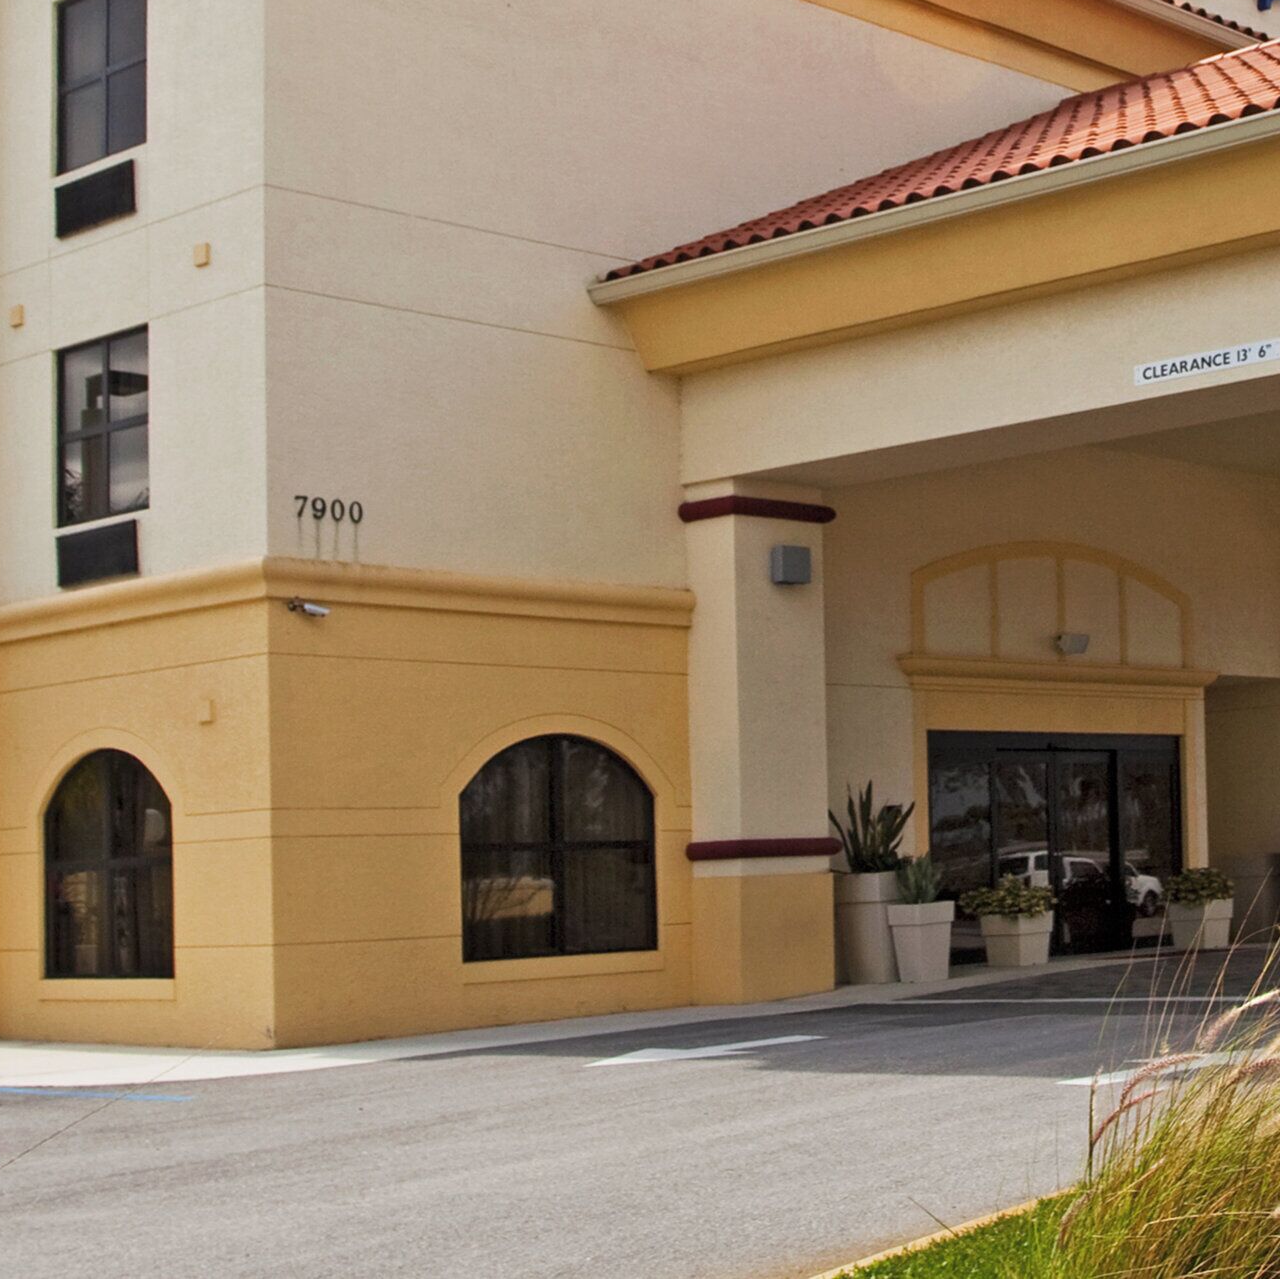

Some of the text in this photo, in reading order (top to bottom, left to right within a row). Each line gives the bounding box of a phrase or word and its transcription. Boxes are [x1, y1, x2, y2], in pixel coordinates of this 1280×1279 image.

[1142, 343, 1273, 381] CLEARANCE 13' 6"
[294, 495, 364, 524] 7900
